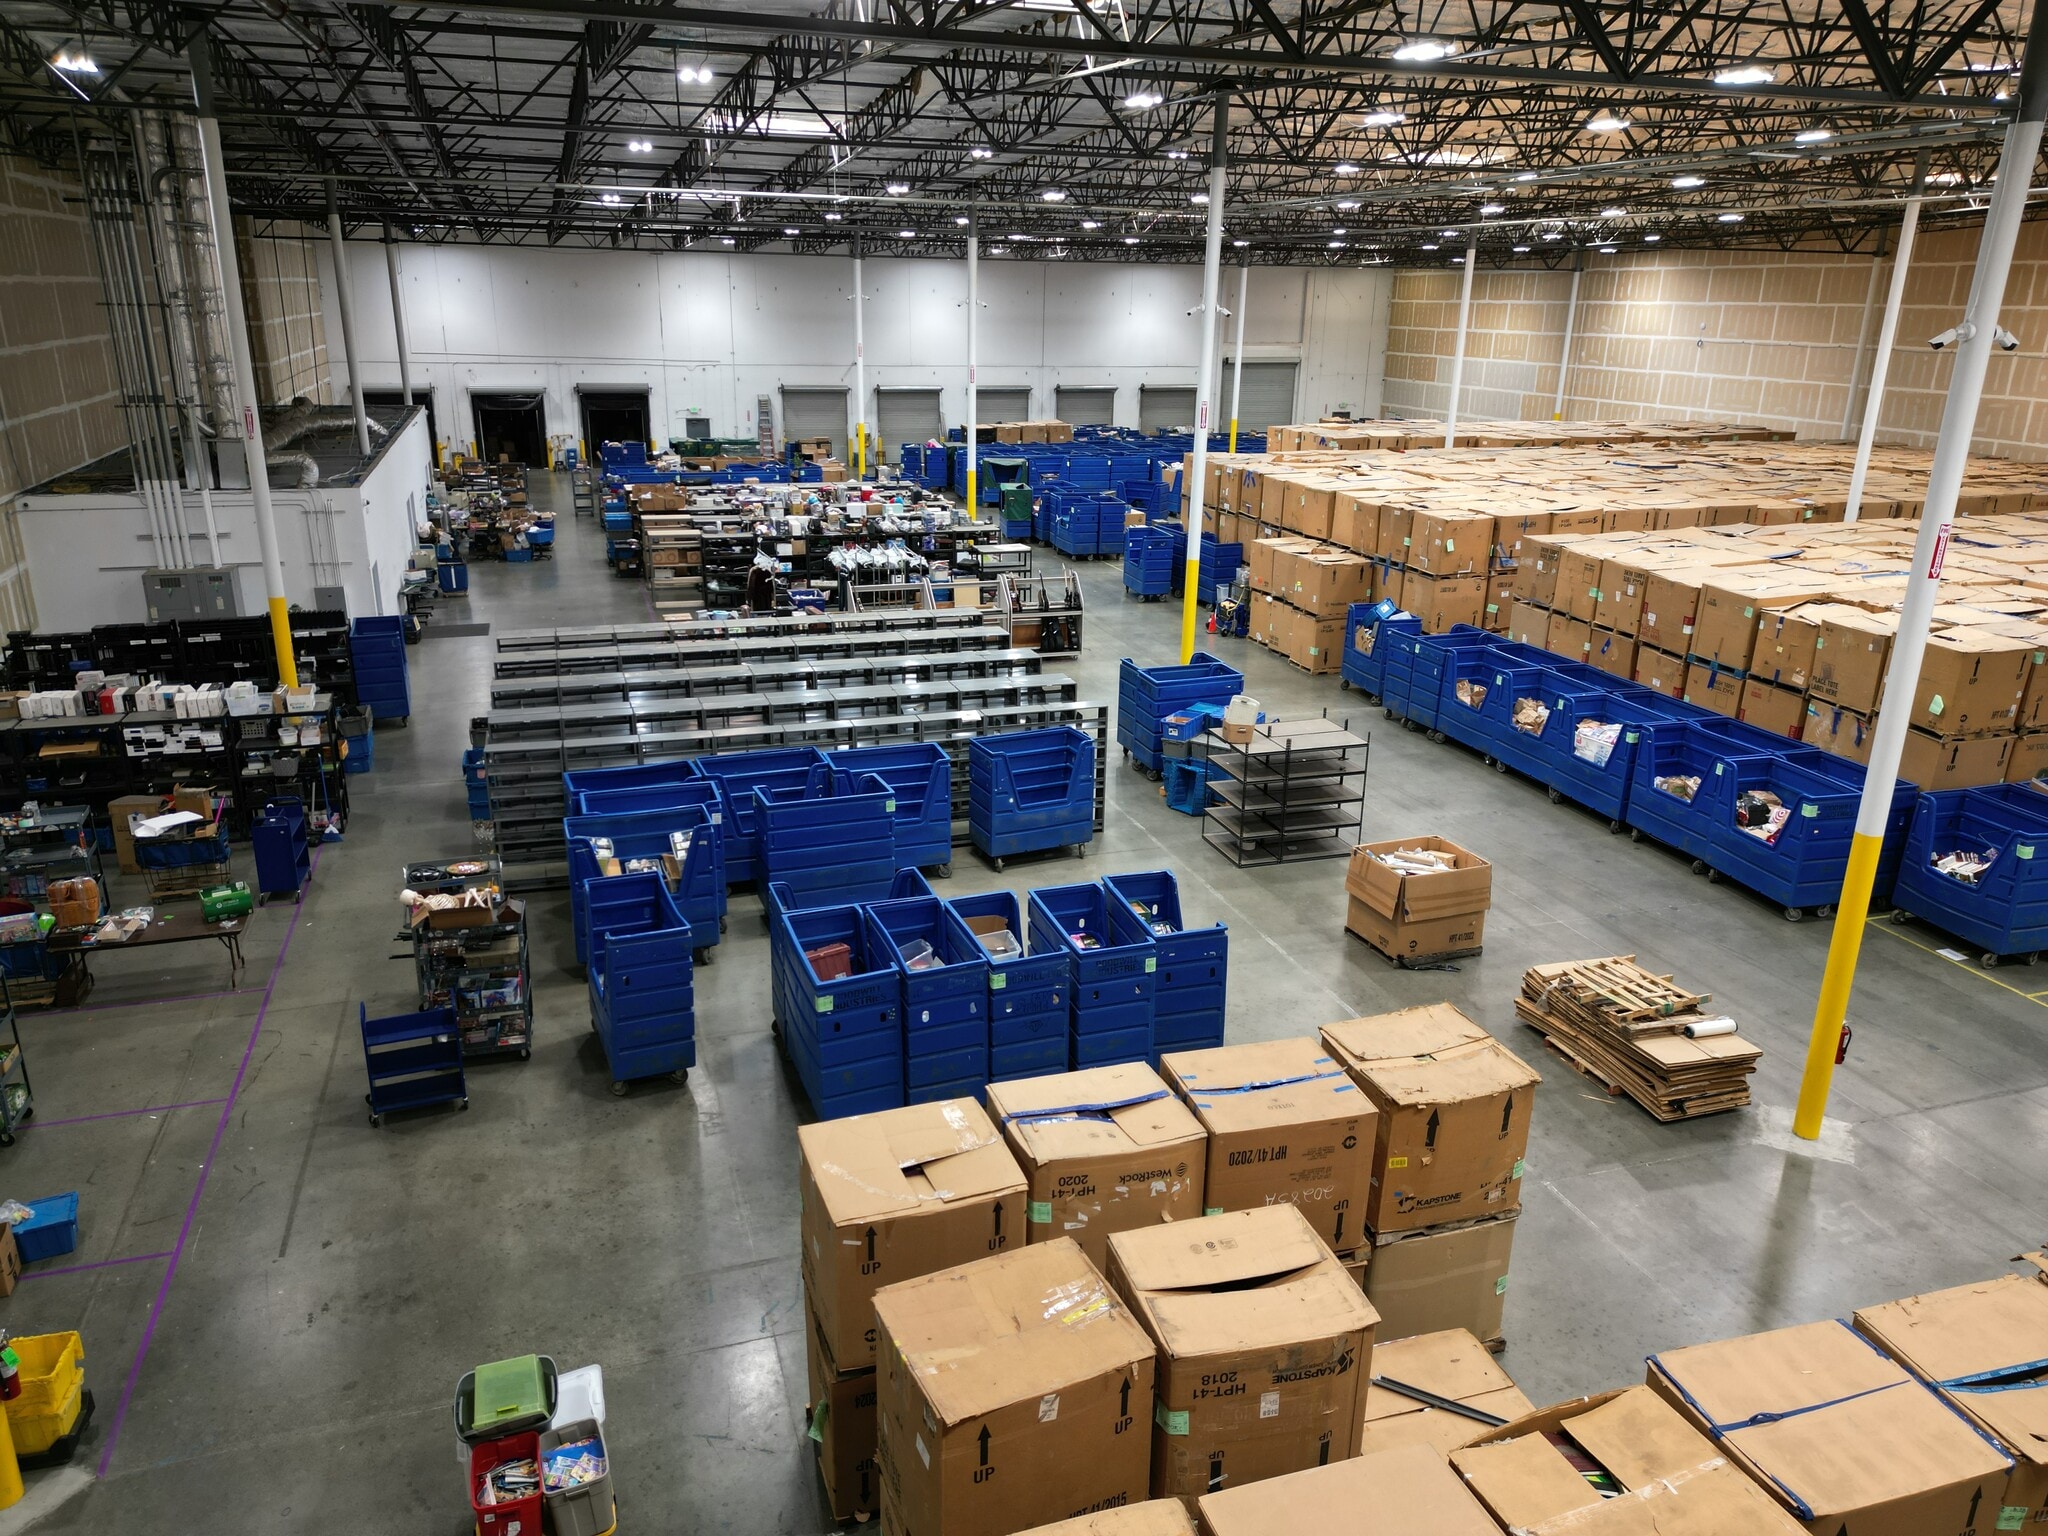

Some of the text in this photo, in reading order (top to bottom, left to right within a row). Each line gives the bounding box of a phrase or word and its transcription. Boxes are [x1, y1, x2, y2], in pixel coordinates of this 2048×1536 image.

[1812, 676, 1838, 690] PLACE TOTE
[1811, 683, 1838, 698] LABEL HERE
[1946, 764, 1956, 772] UP
[1498, 1132, 1508, 1140] UP
[1228, 1148, 1268, 1166] 41/2020
[1058, 1174, 1088, 1186] 2020
[1119, 1168, 1172, 1184] WestRock
[1333, 1200, 1349, 1210] UP
[1416, 1192, 1462, 1206] KAPSTONE
[988, 1235, 1006, 1250] UP
[861, 1262, 881, 1275] UP
[1202, 1372, 1238, 1386] 2018
[1272, 1366, 1337, 1384] KAPSTONE
[1192, 1384, 1246, 1400] HPT-41
[1114, 1416, 1133, 1435] UP
[1318, 1430, 1332, 1441] UP
[1208, 1450, 1224, 1460] UP
[856, 1458, 873, 1472] UP
[974, 1466, 995, 1484] UP
[1090, 1491, 1127, 1515] 41/2015
